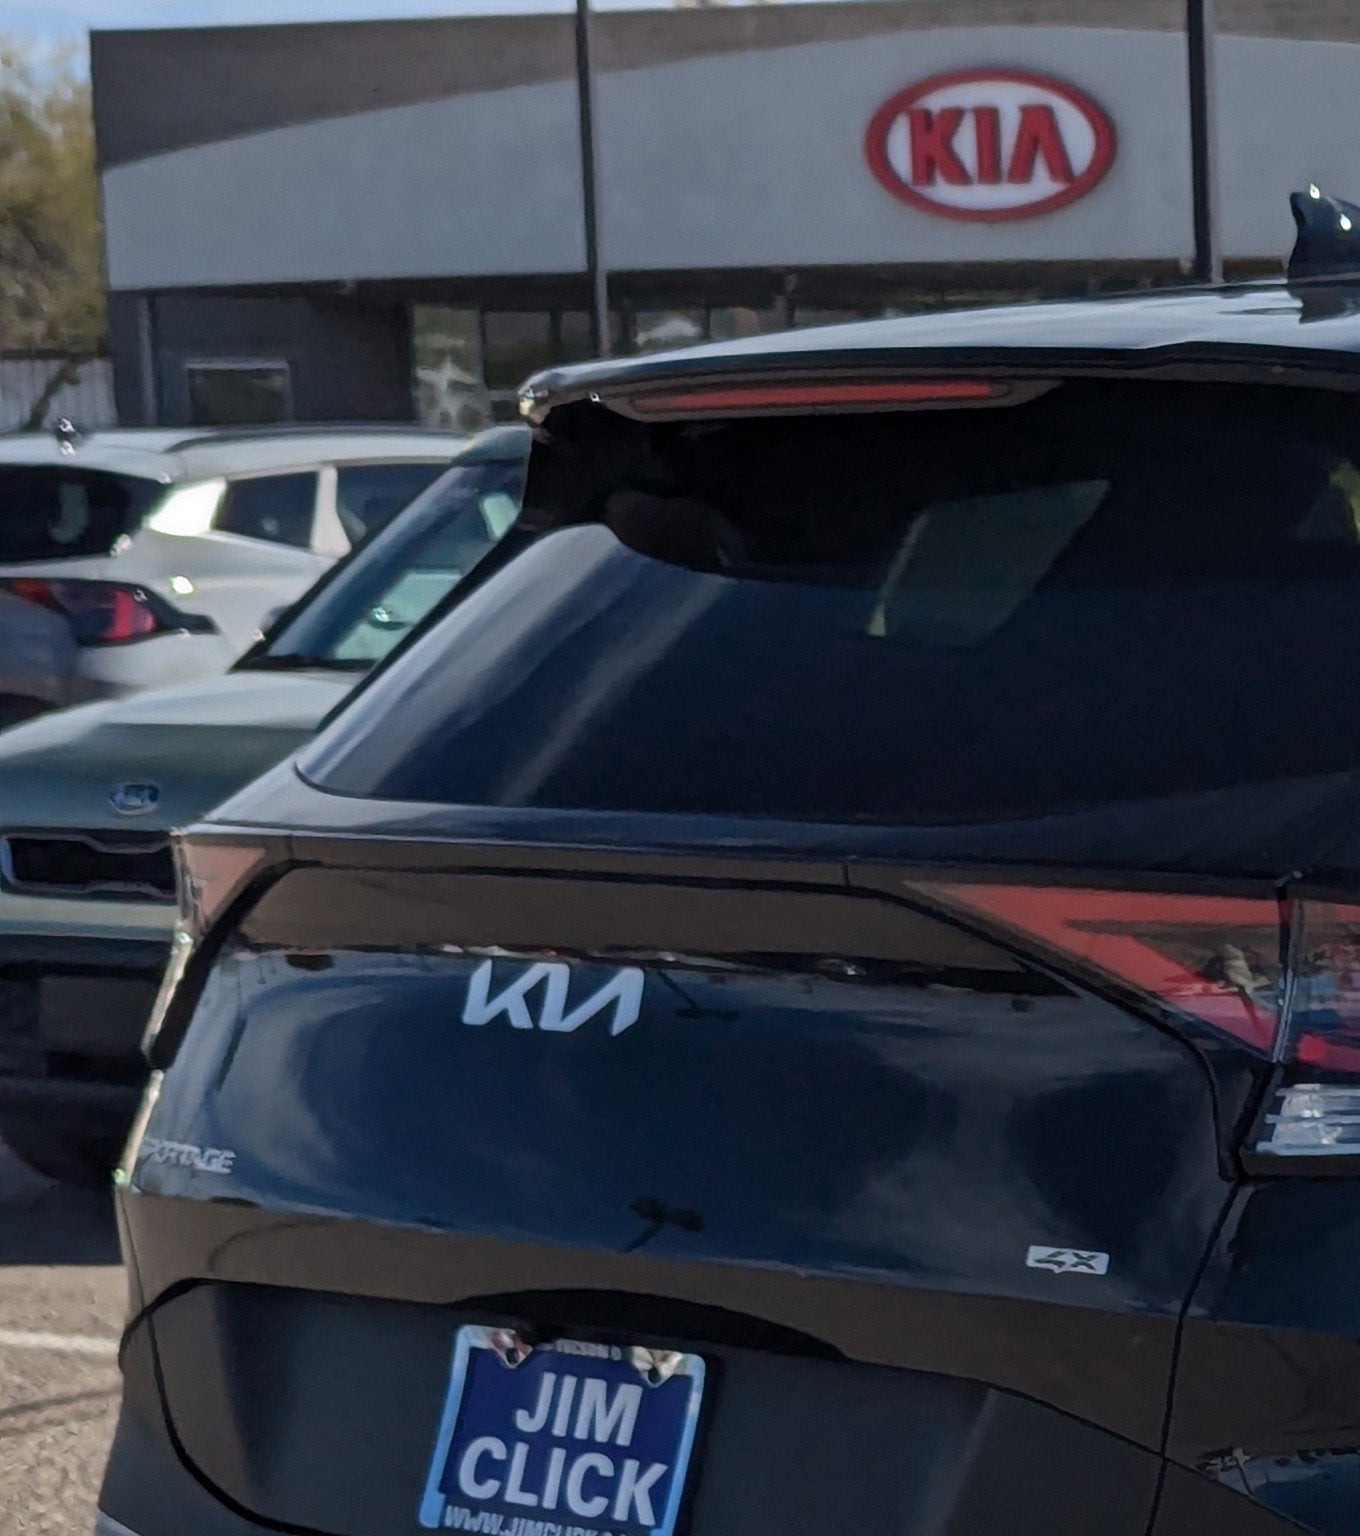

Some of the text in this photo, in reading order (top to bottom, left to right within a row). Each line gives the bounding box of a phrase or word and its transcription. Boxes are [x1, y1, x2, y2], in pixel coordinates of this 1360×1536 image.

[907, 104, 1075, 186] KIA
[462, 959, 645, 1036] KIA
[515, 1371, 643, 1446] JIM
[458, 1436, 669, 1526] CLICK
